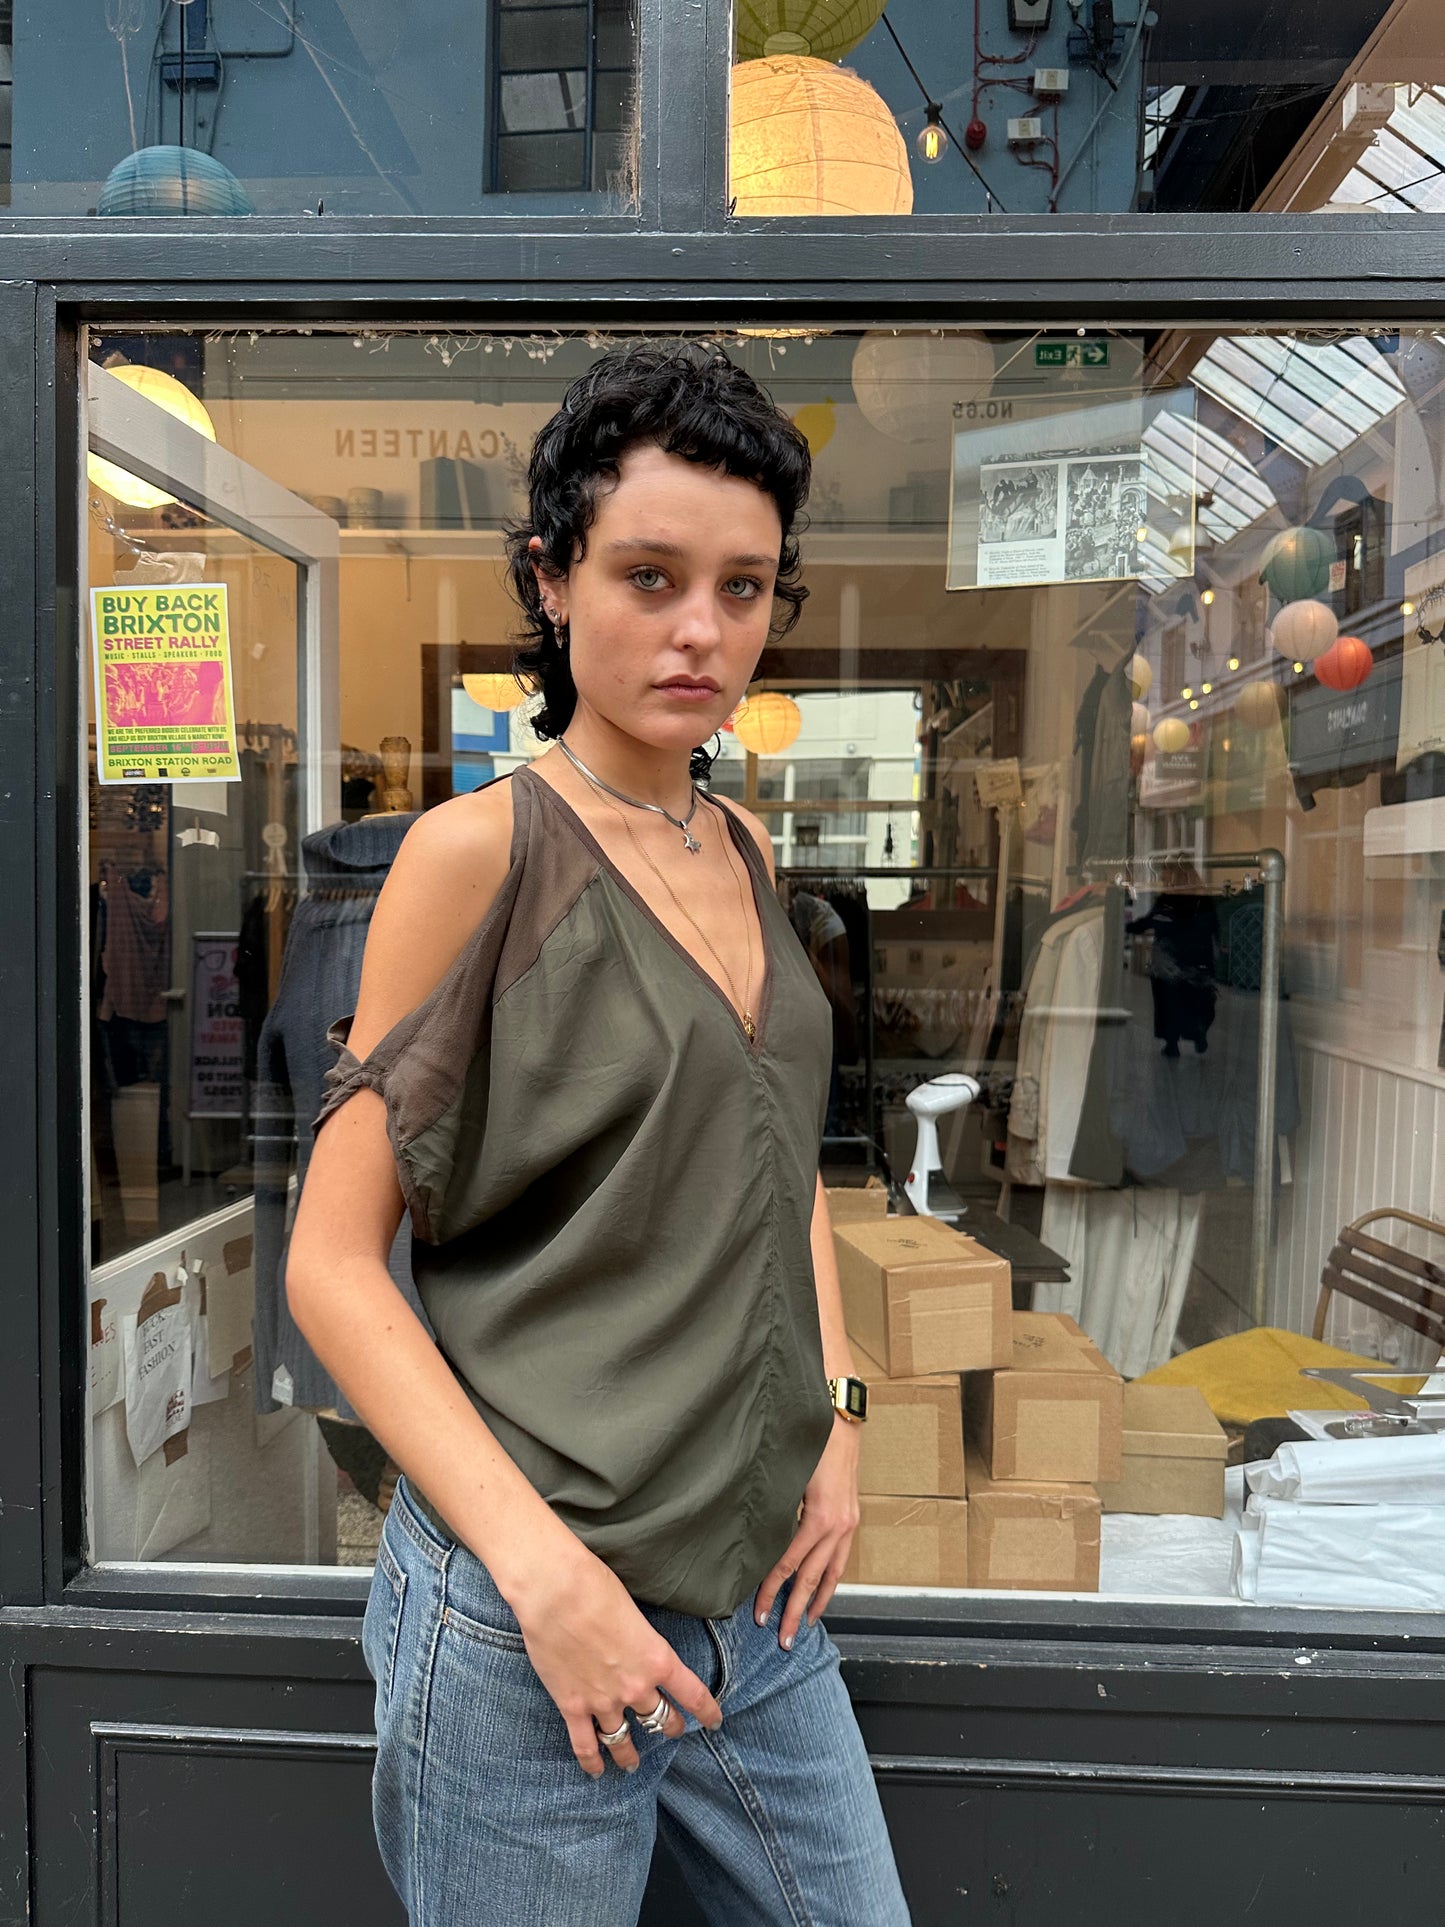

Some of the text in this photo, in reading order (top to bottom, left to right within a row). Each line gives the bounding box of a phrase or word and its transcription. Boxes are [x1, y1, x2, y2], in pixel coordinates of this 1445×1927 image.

[103, 594, 219, 613] BUY BACK
[104, 613, 220, 634] BRIXTON
[104, 635, 219, 651] STREET RALLY
[110, 744, 168, 752] SEPTEMBER
[109, 756, 232, 766] BRIXTON STATION ROAD
[144, 1329, 164, 1355] FAST
[139, 1341, 176, 1380] FASHION
